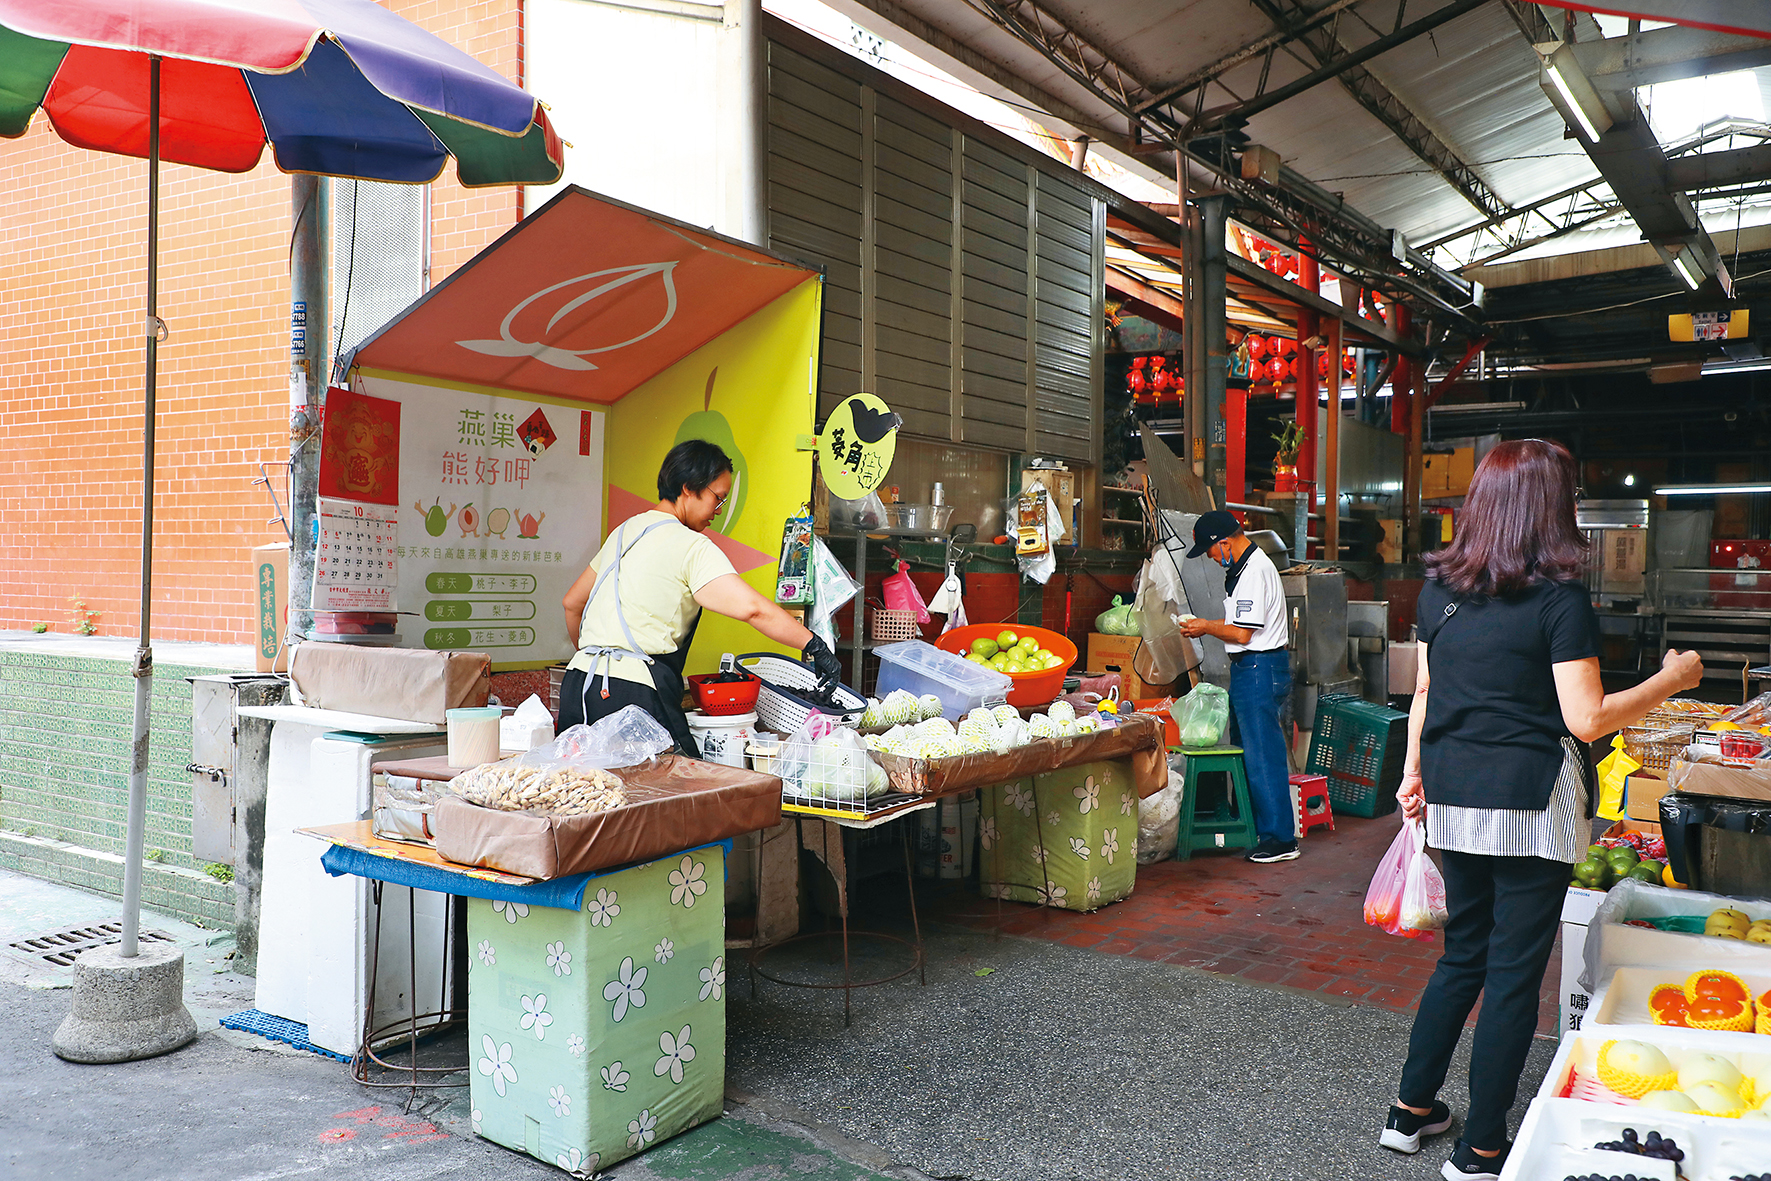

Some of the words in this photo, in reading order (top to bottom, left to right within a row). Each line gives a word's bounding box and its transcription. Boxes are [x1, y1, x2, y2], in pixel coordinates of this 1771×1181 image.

[458, 409, 515, 448] 燕巢
[442, 451, 530, 490] 熊好呷
[354, 506, 363, 517] 10
[436, 577, 457, 589] 春天
[476, 577, 529, 590] 桃子、李子
[435, 605, 456, 618] 夏天
[492, 604, 512, 617] 梨子
[434, 632, 456, 644] 秋冬
[475, 630, 527, 643] 花生、菱角
